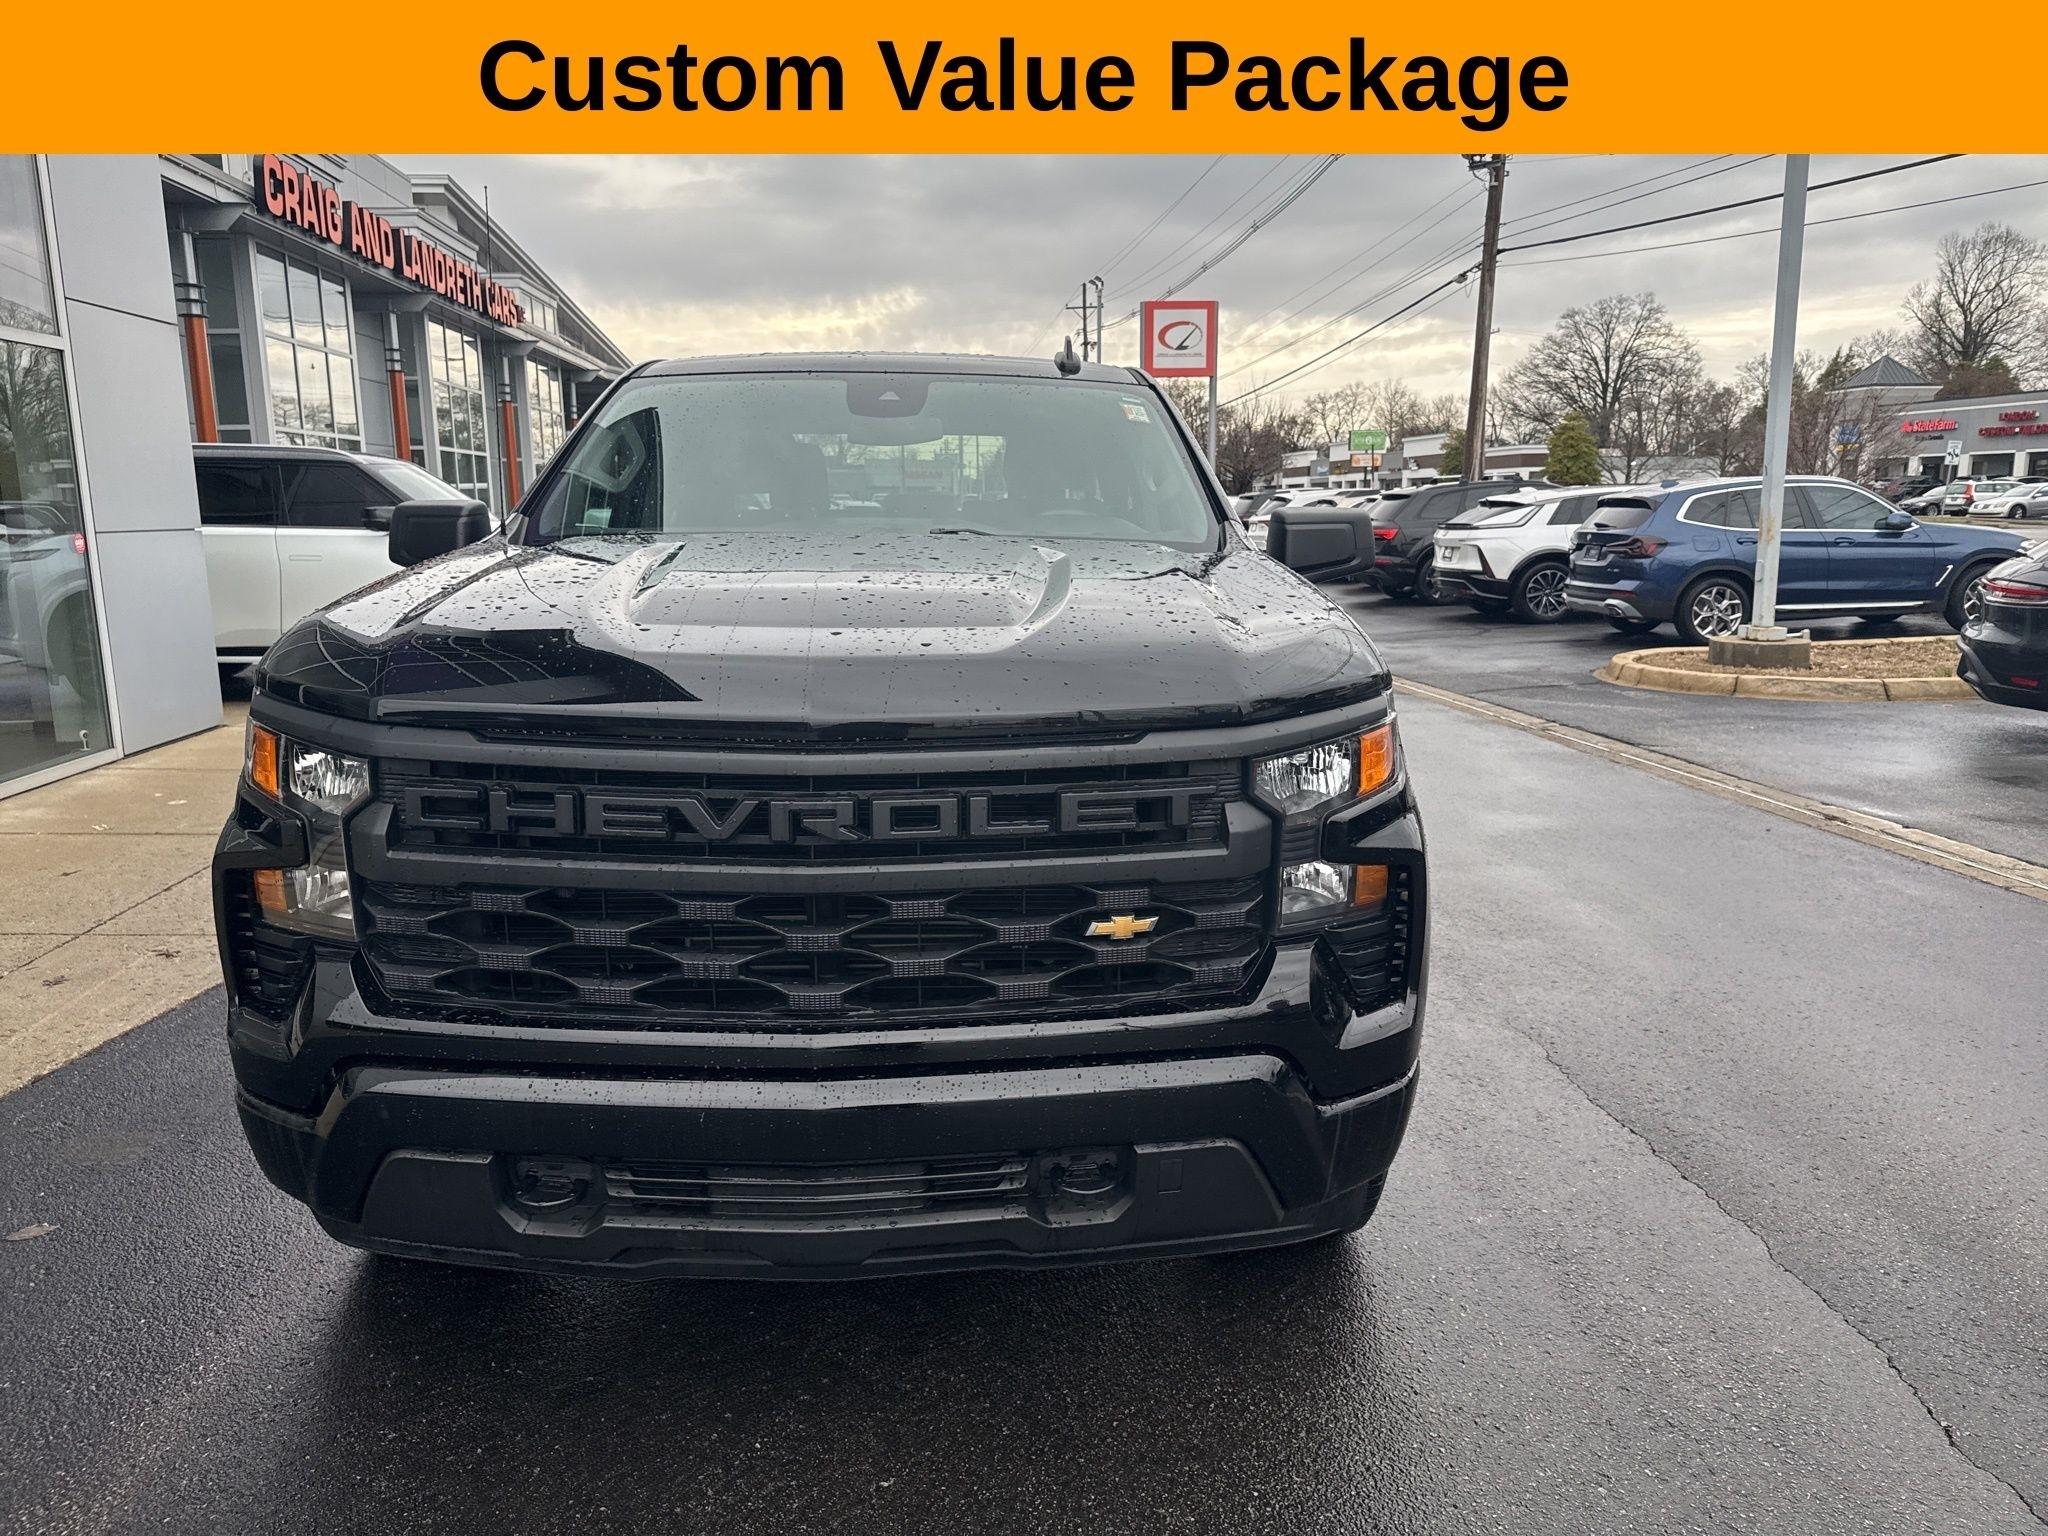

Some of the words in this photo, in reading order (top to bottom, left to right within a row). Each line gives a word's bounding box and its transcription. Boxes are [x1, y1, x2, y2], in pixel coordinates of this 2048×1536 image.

[263, 154, 343, 246] CRAIG
[351, 201, 395, 270] AND
[399, 227, 483, 313] LANDRETH
[485, 277, 518, 329] CARS
[402, 783, 1219, 842] CHEVROLET
